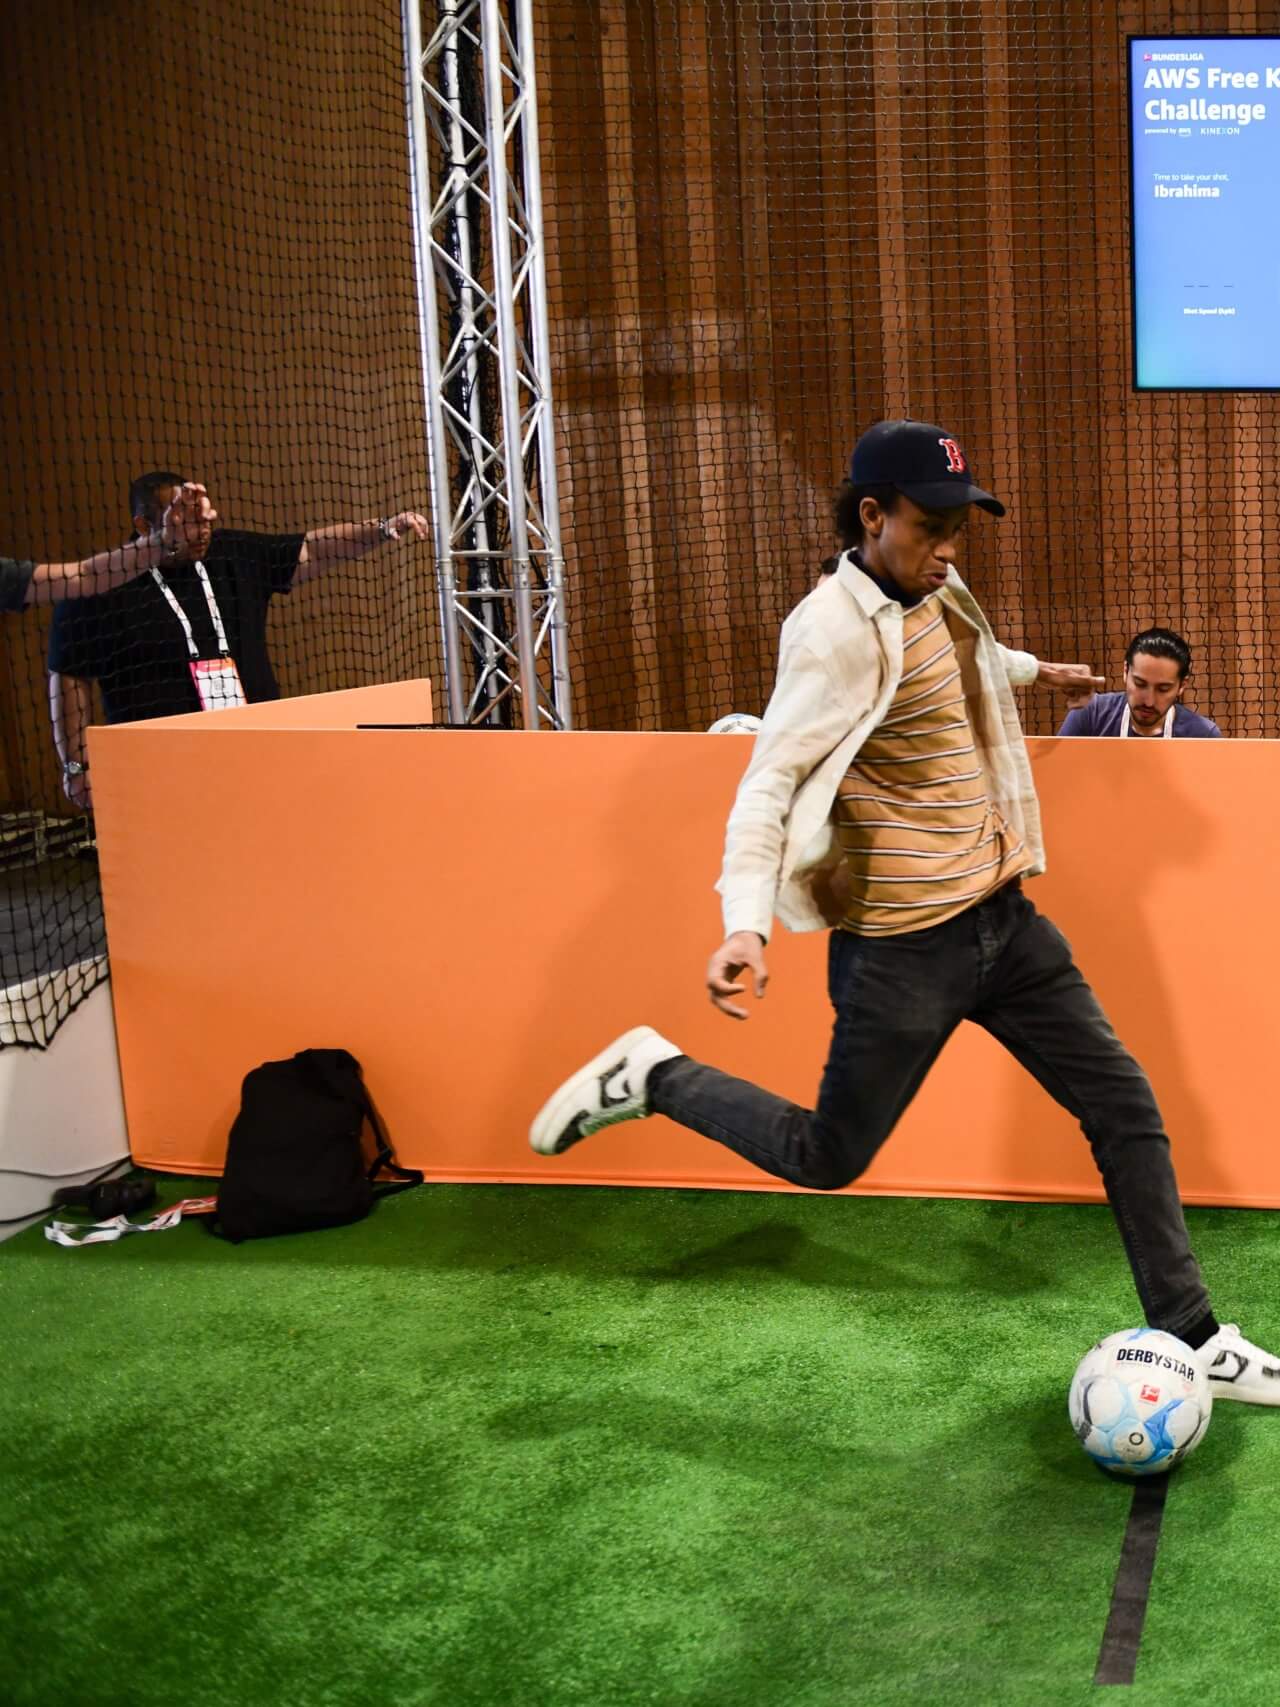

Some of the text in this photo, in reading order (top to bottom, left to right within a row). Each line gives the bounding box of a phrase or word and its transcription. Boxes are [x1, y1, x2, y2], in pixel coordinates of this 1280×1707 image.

[1152, 53, 1204, 61] BUNDESLIGA
[1143, 68, 1201, 89] AWS
[1207, 67, 1259, 89] Free
[1144, 99, 1266, 125] Challenge
[1144, 128, 1169, 136] powered
[1169, 128, 1177, 136] by
[1200, 127, 1240, 135] KINEXON
[1153, 173, 1171, 181] Time
[1180, 173, 1195, 181] take
[1196, 174, 1212, 183] your
[1154, 184, 1220, 198] Ibrahima
[938, 438, 965, 473] B
[1116, 1348, 1196, 1382] DERBYSTAR
